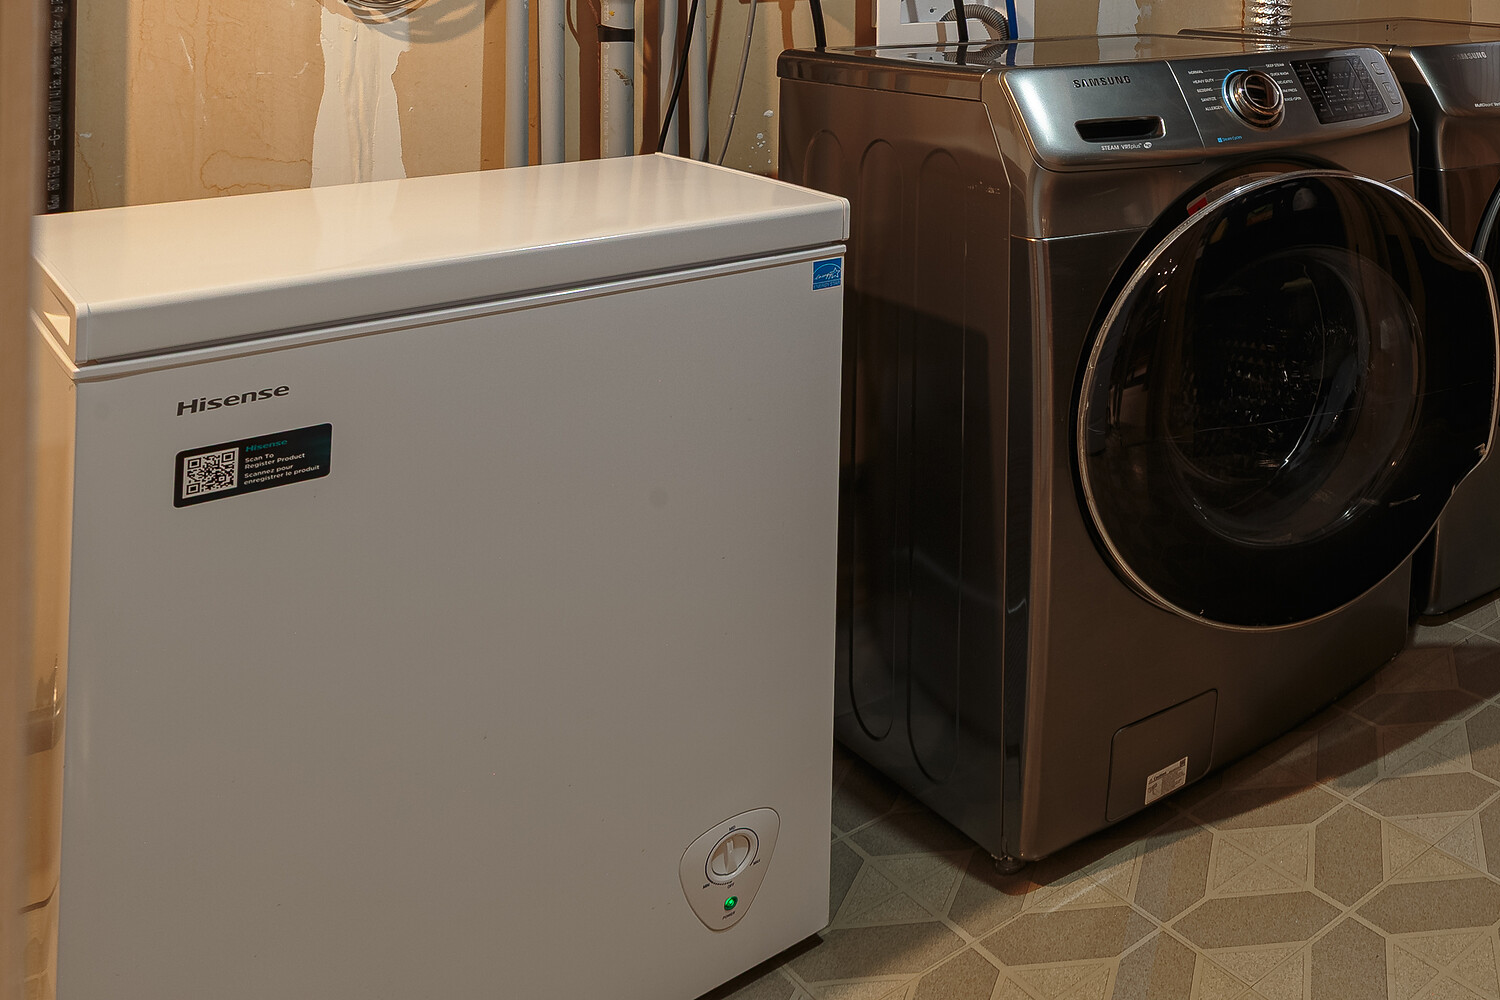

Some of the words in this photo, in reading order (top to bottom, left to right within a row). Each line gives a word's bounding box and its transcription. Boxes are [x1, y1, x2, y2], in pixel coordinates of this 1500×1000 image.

[1453, 51, 1487, 60] AMSUNG
[1073, 75, 1131, 88] SAMSUNG
[176, 385, 290, 416] Hisense
[245, 439, 288, 452] Hisense
[244, 455, 263, 464] Scan
[244, 459, 275, 470] Register
[277, 452, 306, 464] Product
[243, 473, 284, 485] enregistrer
[294, 465, 320, 476] produit
[244, 468, 275, 479] Scannez
[276, 464, 294, 472] pour
[722, 911, 736, 920] POWER
